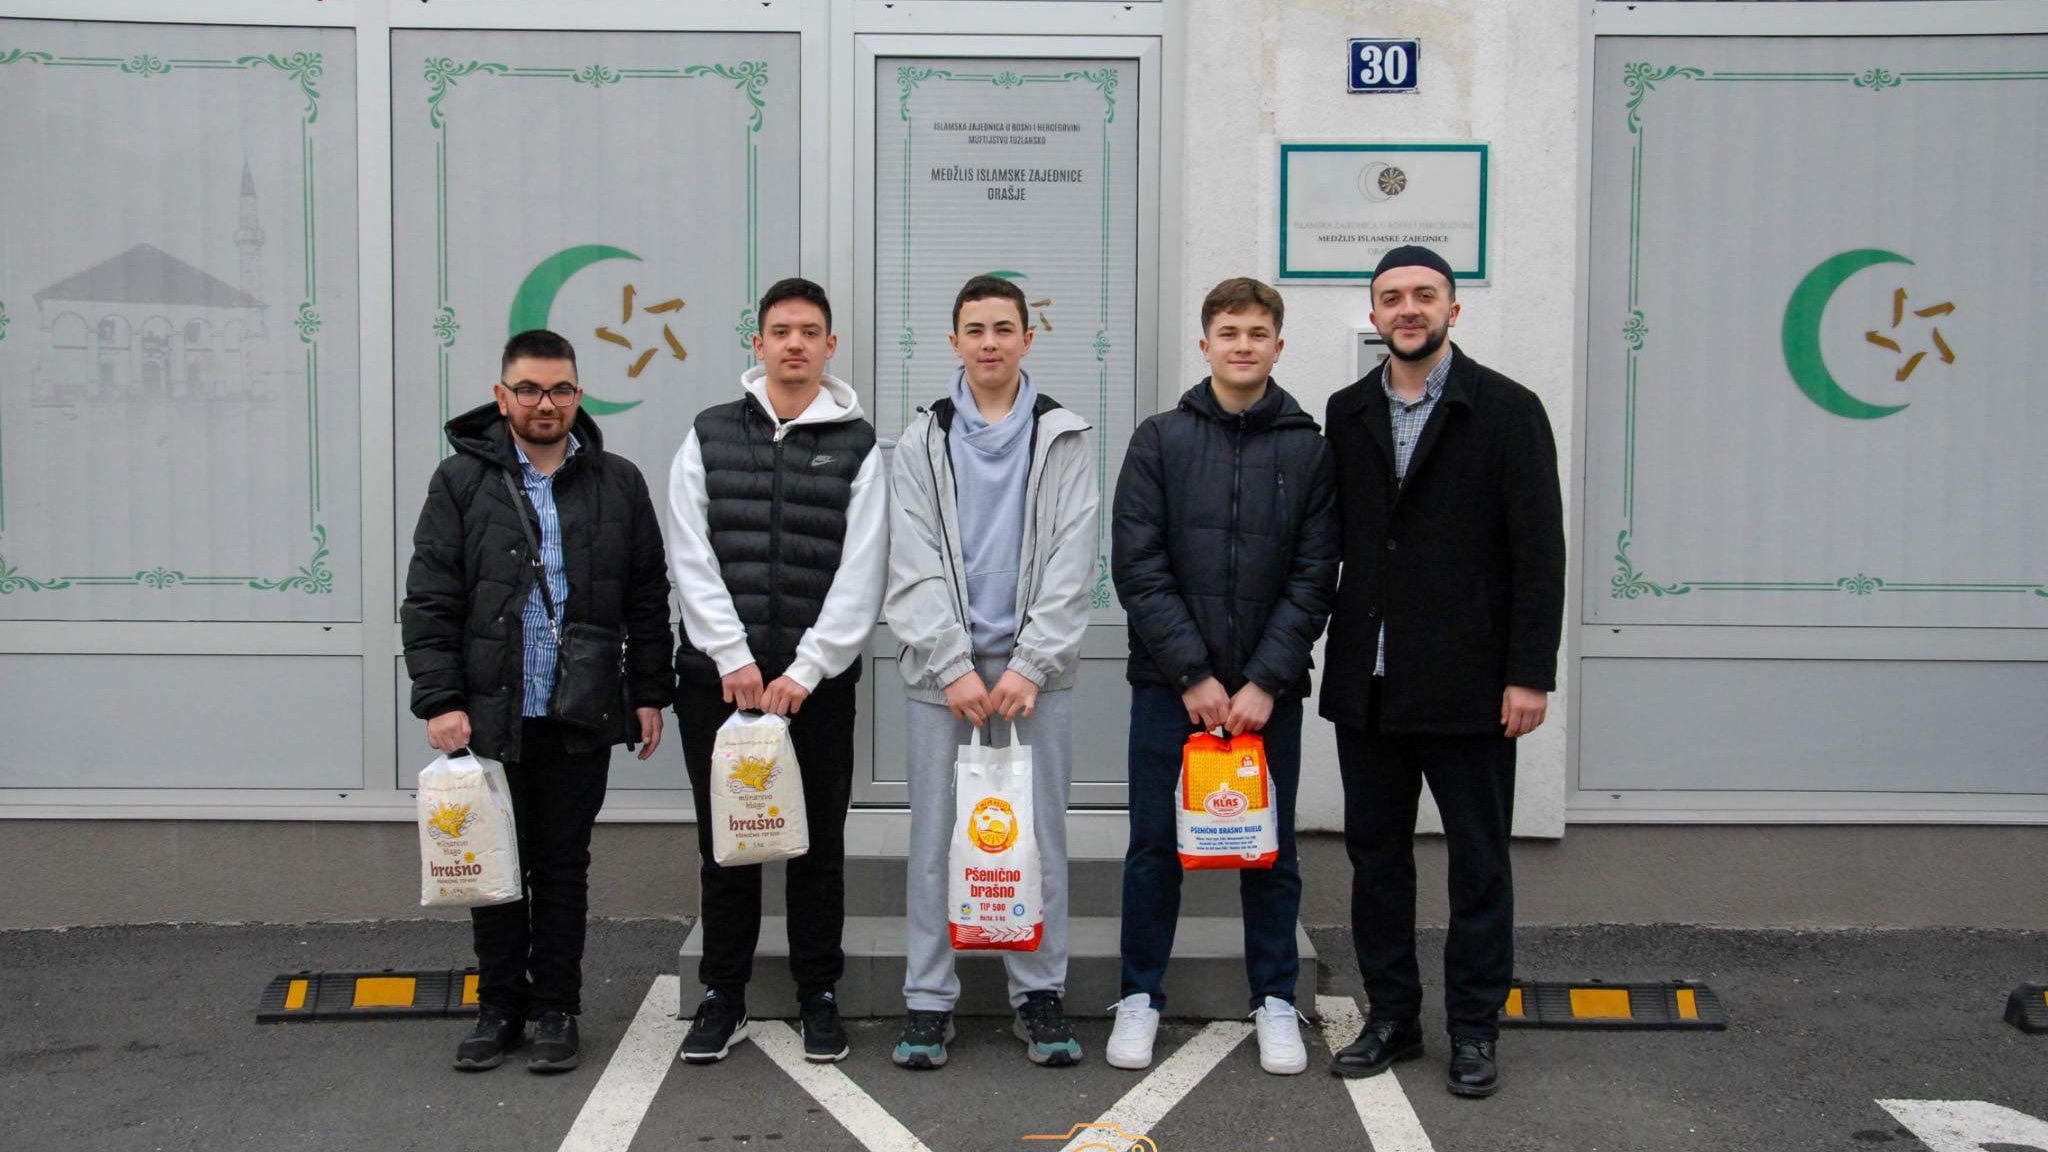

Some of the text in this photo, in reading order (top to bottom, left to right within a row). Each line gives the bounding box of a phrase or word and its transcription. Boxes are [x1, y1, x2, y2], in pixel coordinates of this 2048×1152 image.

[1360, 45, 1408, 85] 30
[934, 122, 967, 131] ISLAMSKA
[968, 122, 1005, 131] ZAJEDNICA
[931, 165, 1083, 183] MEDŽLIS ISLAMSKE ZAJEDNICE
[987, 185, 1027, 201] ORAŠJE
[1317, 232, 1356, 242] MEDŽLIS
[1358, 234, 1400, 242] ISLAMSKE
[1213, 798, 1239, 808] KLAS
[729, 813, 785, 831] brašno
[430, 860, 482, 877] brašno
[965, 867, 1021, 882] Pšenično
[970, 883, 1015, 898] brašno
[980, 903, 1006, 911] TIP 500
